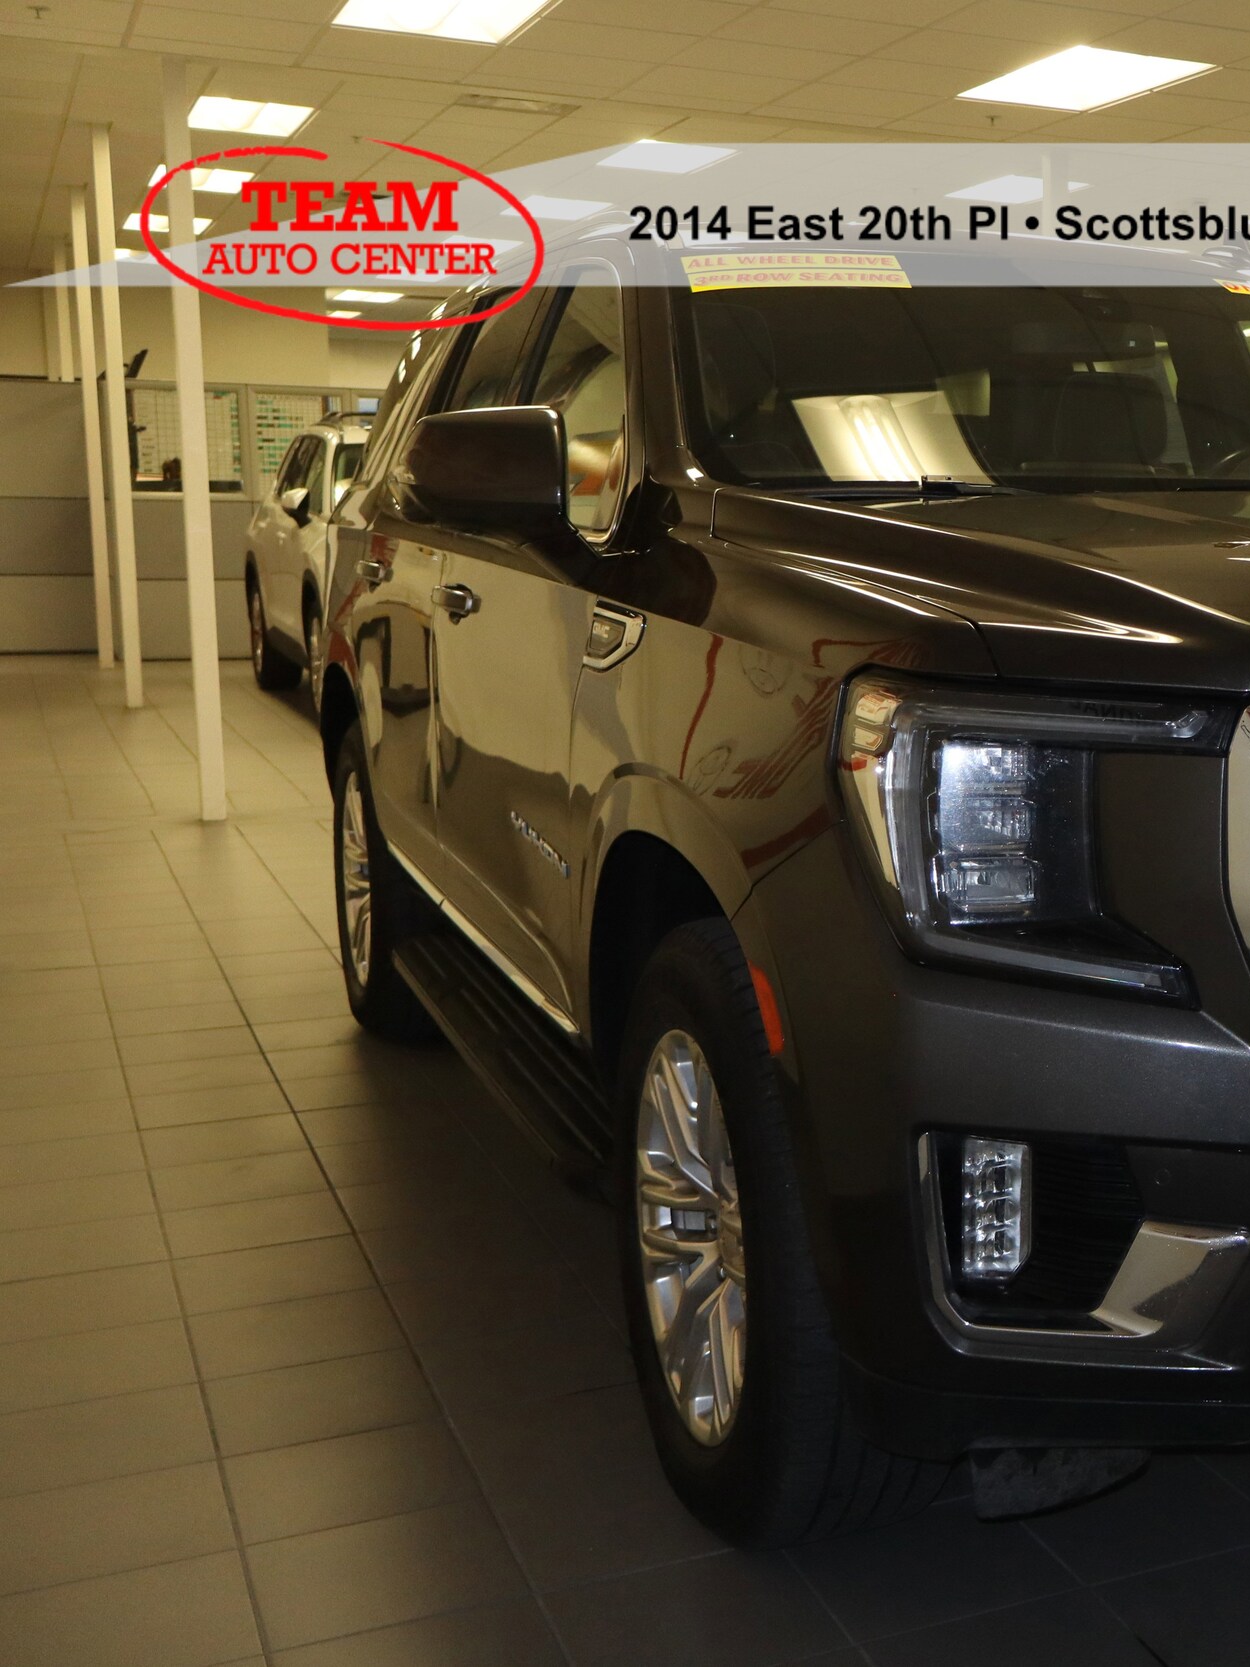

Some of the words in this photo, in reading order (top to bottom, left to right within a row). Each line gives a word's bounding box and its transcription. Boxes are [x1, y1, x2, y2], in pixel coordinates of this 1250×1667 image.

[688, 256, 728, 269] ALL
[736, 255, 818, 265] WHEEL
[823, 255, 895, 266] DRIVE
[736, 272, 794, 283] ROW
[799, 272, 904, 283] SEATING
